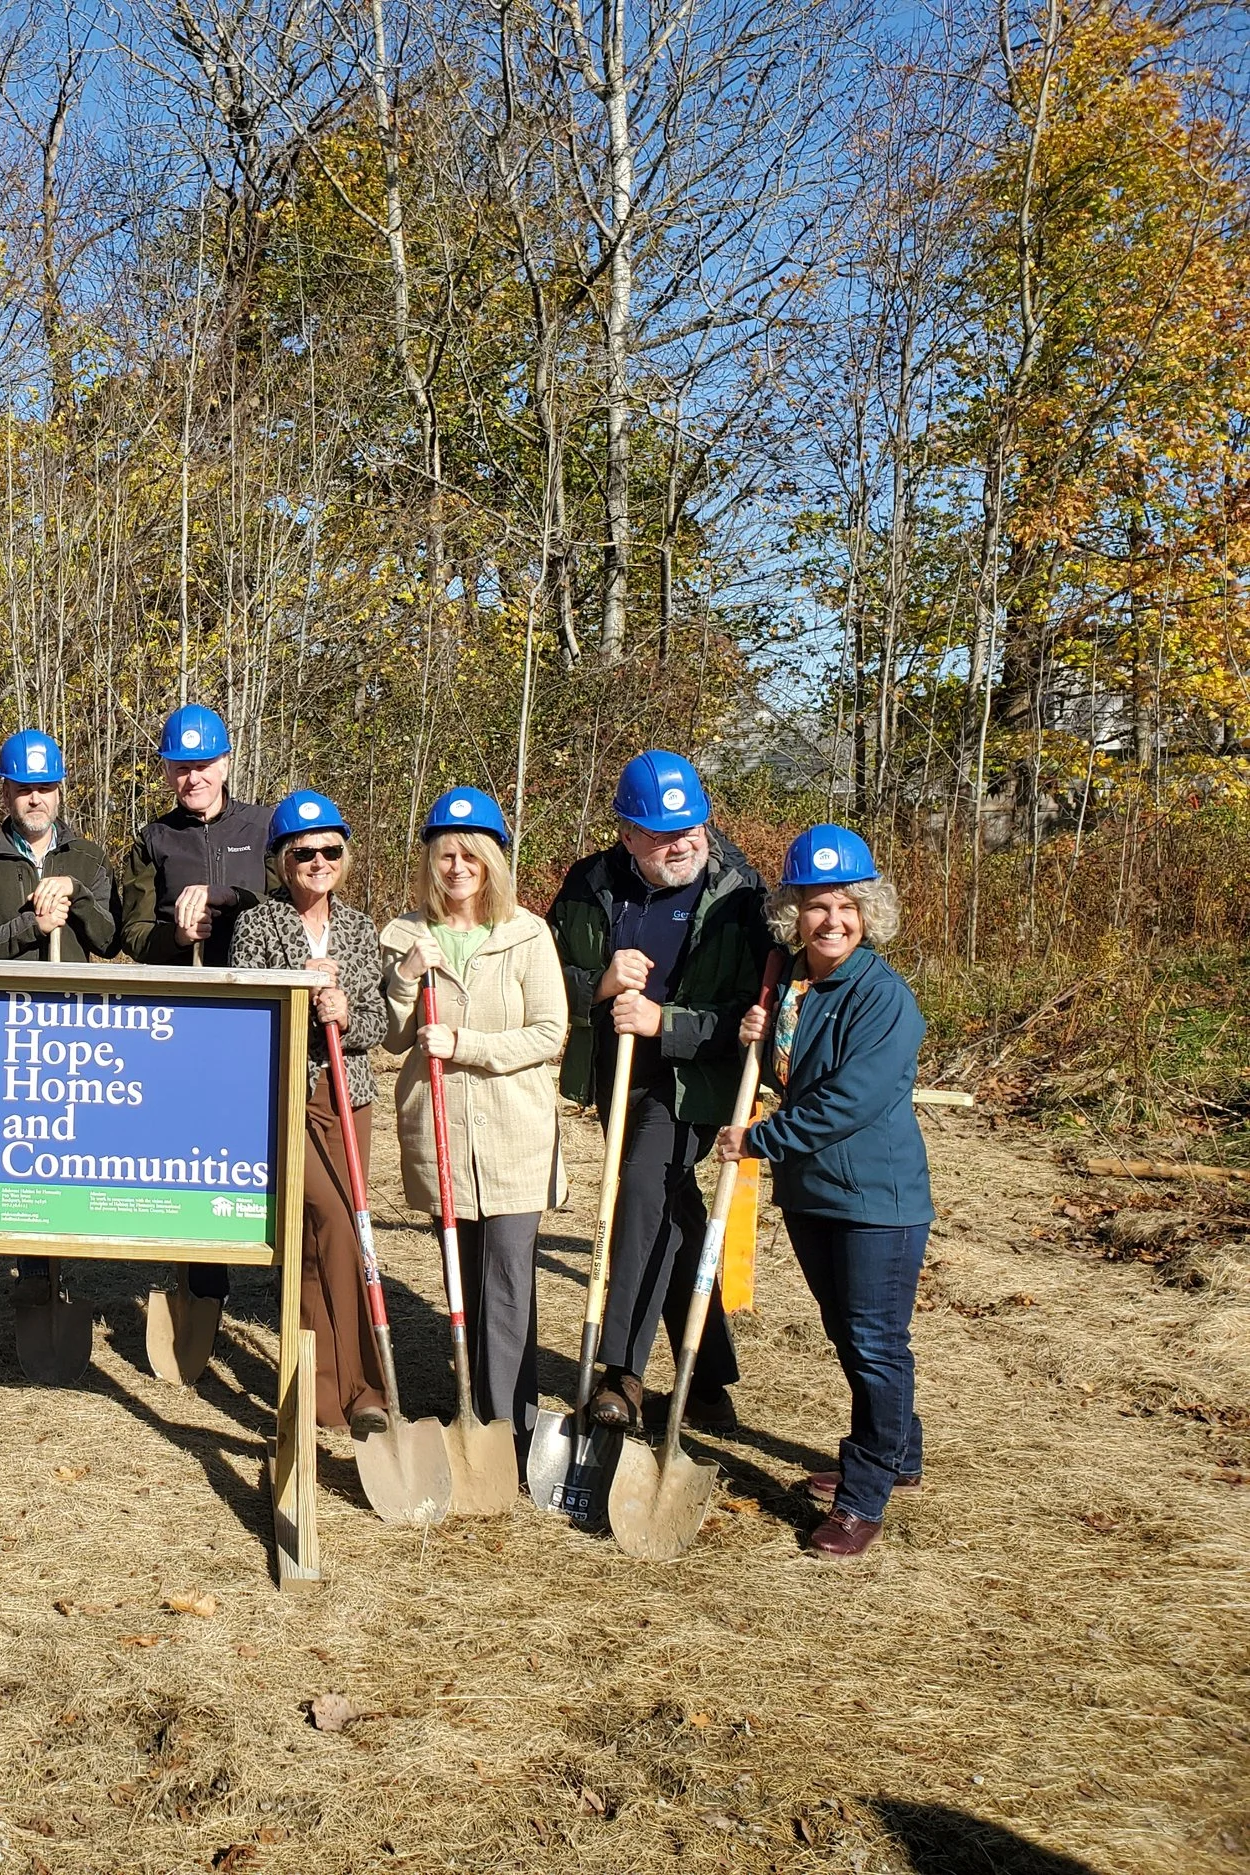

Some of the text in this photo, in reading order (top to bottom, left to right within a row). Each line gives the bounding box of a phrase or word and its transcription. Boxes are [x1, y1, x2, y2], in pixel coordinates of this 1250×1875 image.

[227, 845, 252, 853] Marmot
[4, 991, 175, 1041] Building
[3, 1028, 125, 1076] Hope,
[2, 1065, 144, 1106] Homes
[2, 1103, 77, 1141] and
[1, 1140, 269, 1187] Communities
[594, 1219, 607, 1260] SEYMOUR
